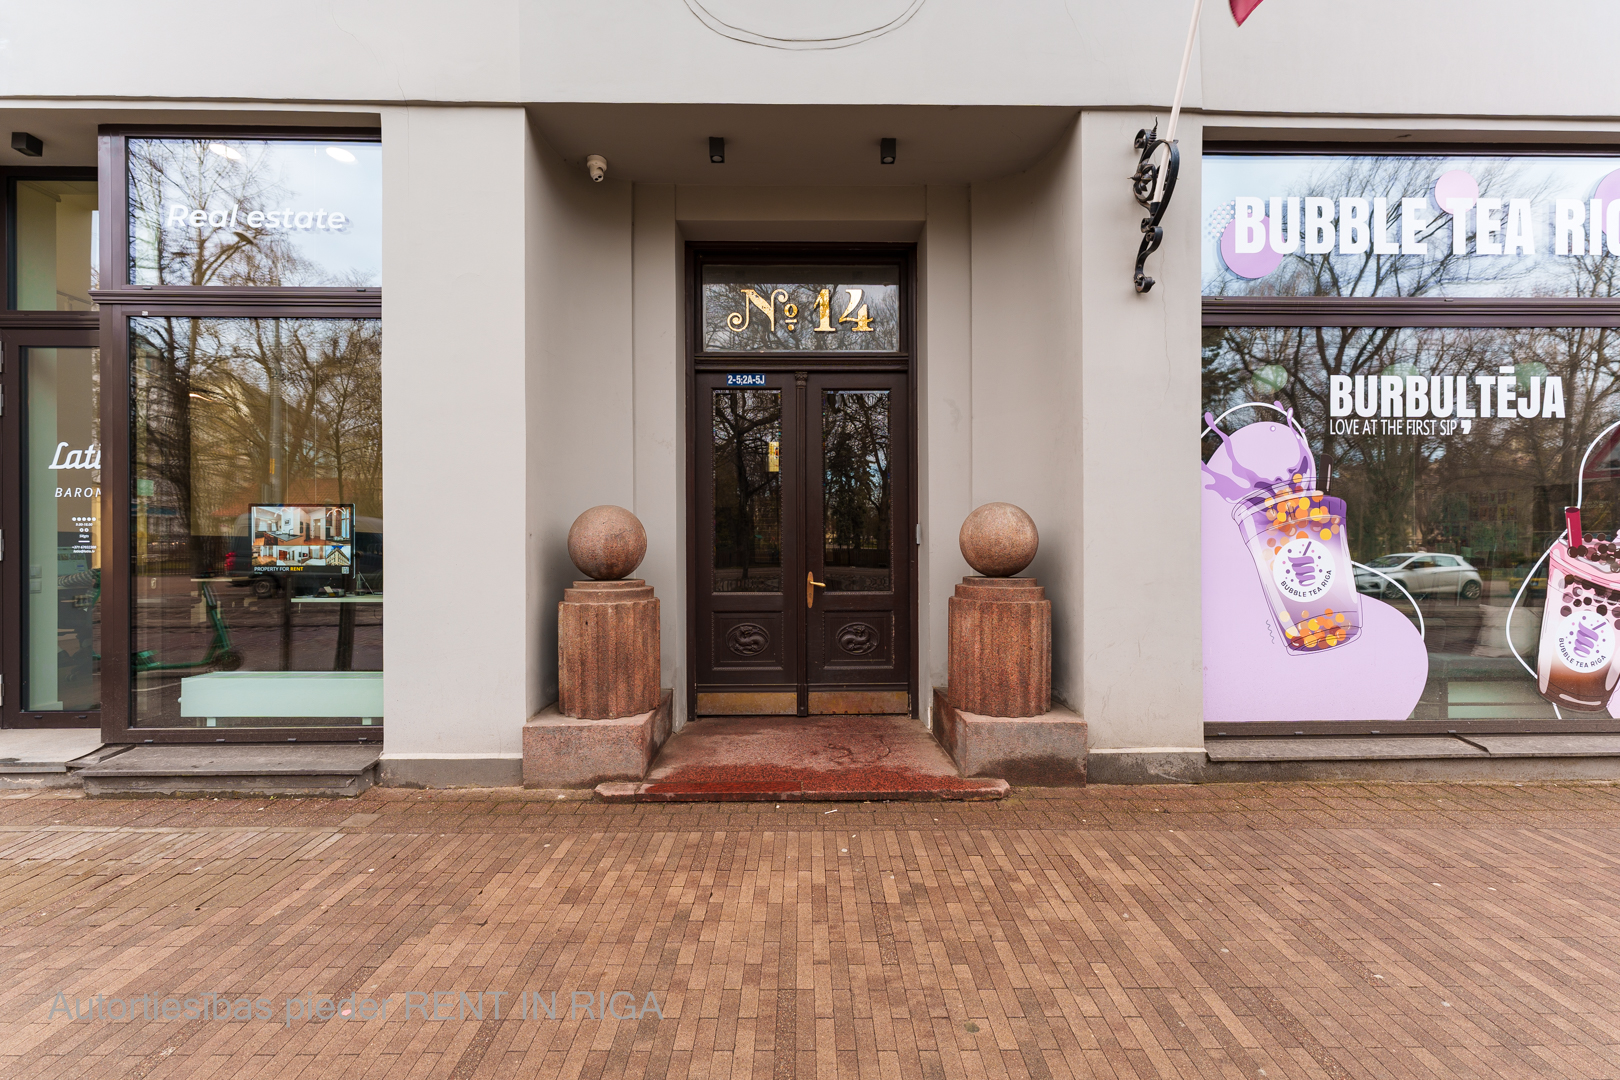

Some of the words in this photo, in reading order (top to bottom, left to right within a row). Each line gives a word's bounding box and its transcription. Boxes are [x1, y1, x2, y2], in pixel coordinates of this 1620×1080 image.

[167, 204, 239, 228] Real
[246, 207, 346, 229] estate
[1235, 196, 1428, 255] BUBBLE
[1446, 197, 1536, 256] TEA
[813, 288, 874, 332] 14
[1330, 419, 1359, 435] LOVE
[1362, 419, 1378, 435] AT
[1381, 419, 1403, 435] THE
[1406, 419, 1437, 435] FIRST
[1440, 420, 1458, 436] SIP
[1280, 580, 1307, 598] BUBBLE
[1308, 586, 1322, 597] TEA
[1320, 569, 1333, 588] RIGA
[1558, 637, 1575, 664] BUBBLE
[1575, 660, 1589, 668] TEA
[1590, 655, 1607, 667] RIGA
